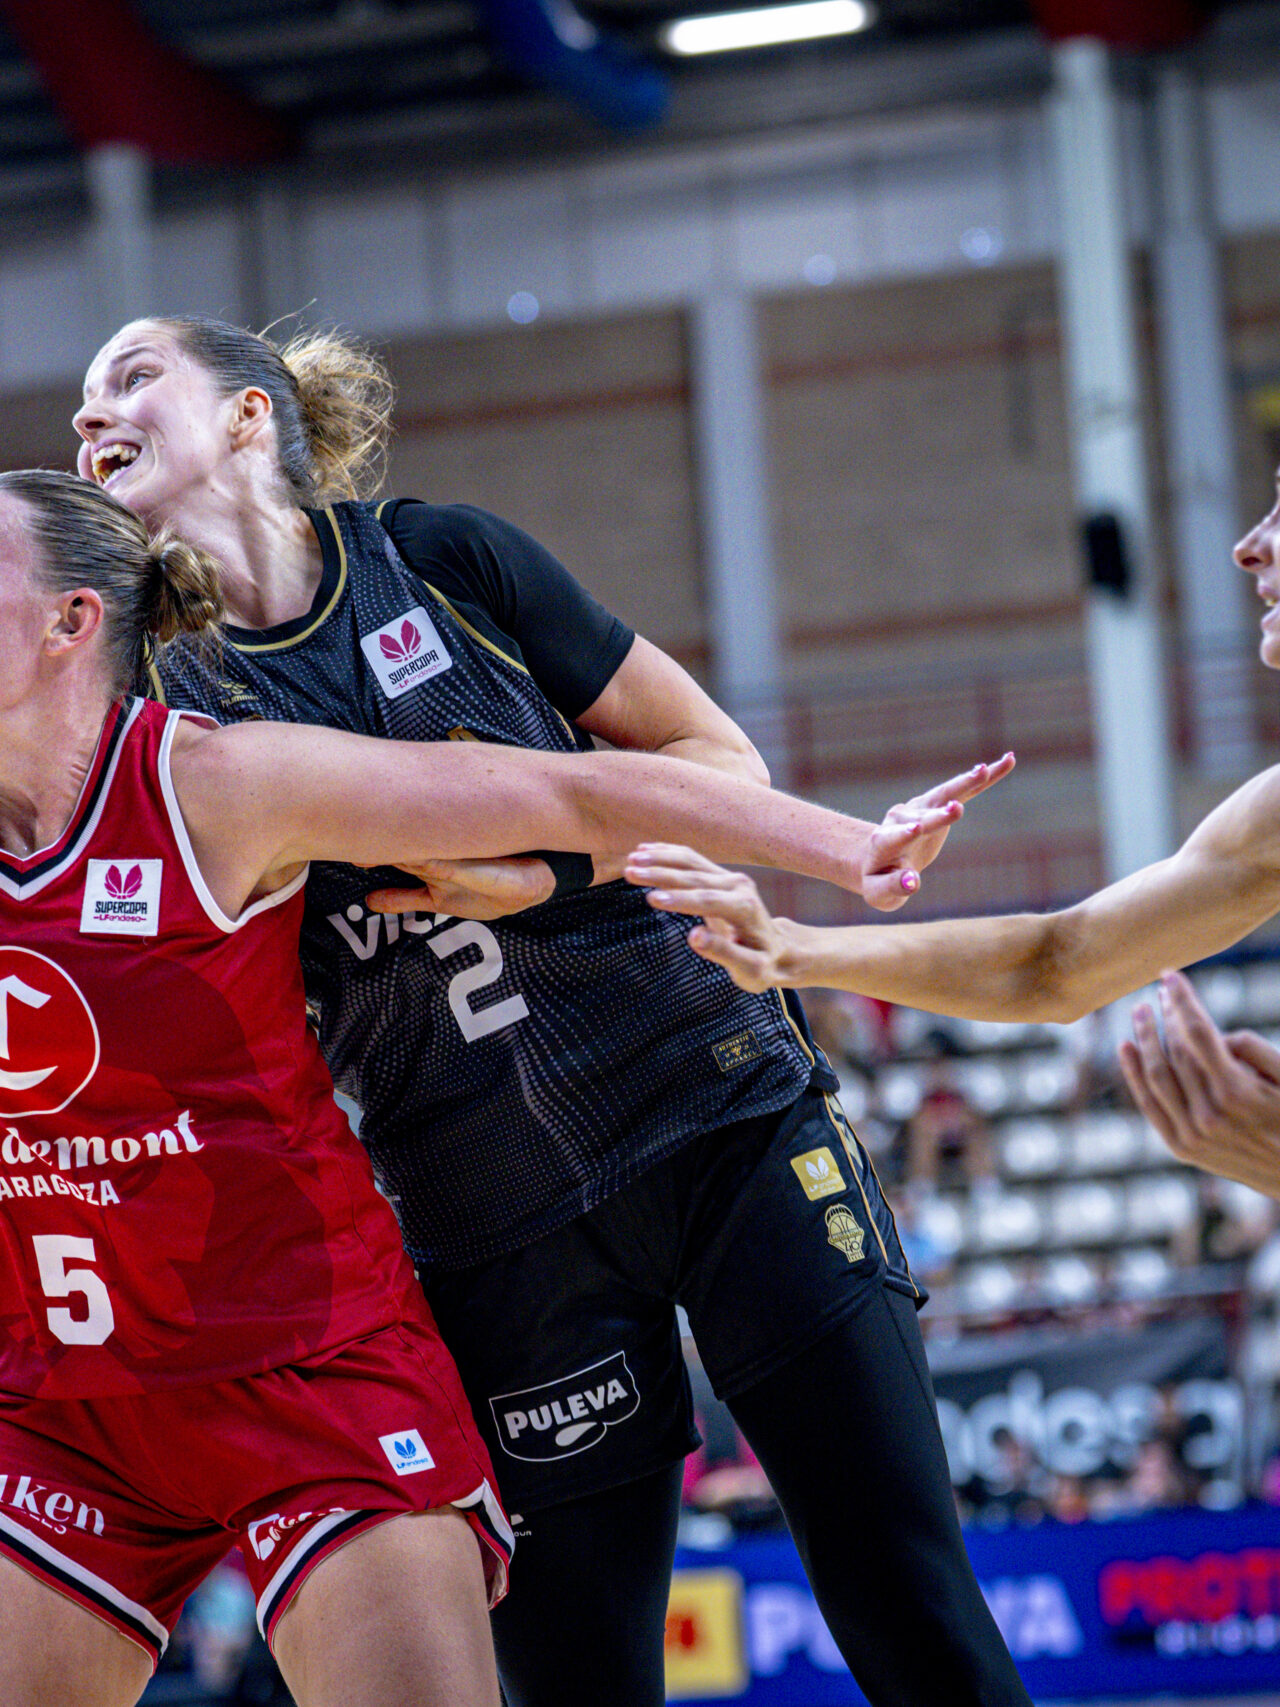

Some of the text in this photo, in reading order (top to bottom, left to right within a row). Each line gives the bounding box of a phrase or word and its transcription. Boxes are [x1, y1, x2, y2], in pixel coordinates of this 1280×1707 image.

[388, 649, 440, 685] SUPERCOPA
[95, 901, 148, 914] SUPERCOPA
[426, 920, 530, 1043] 2
[32, 1234, 115, 1346] 5
[504, 1378, 629, 1440] PULEVA
